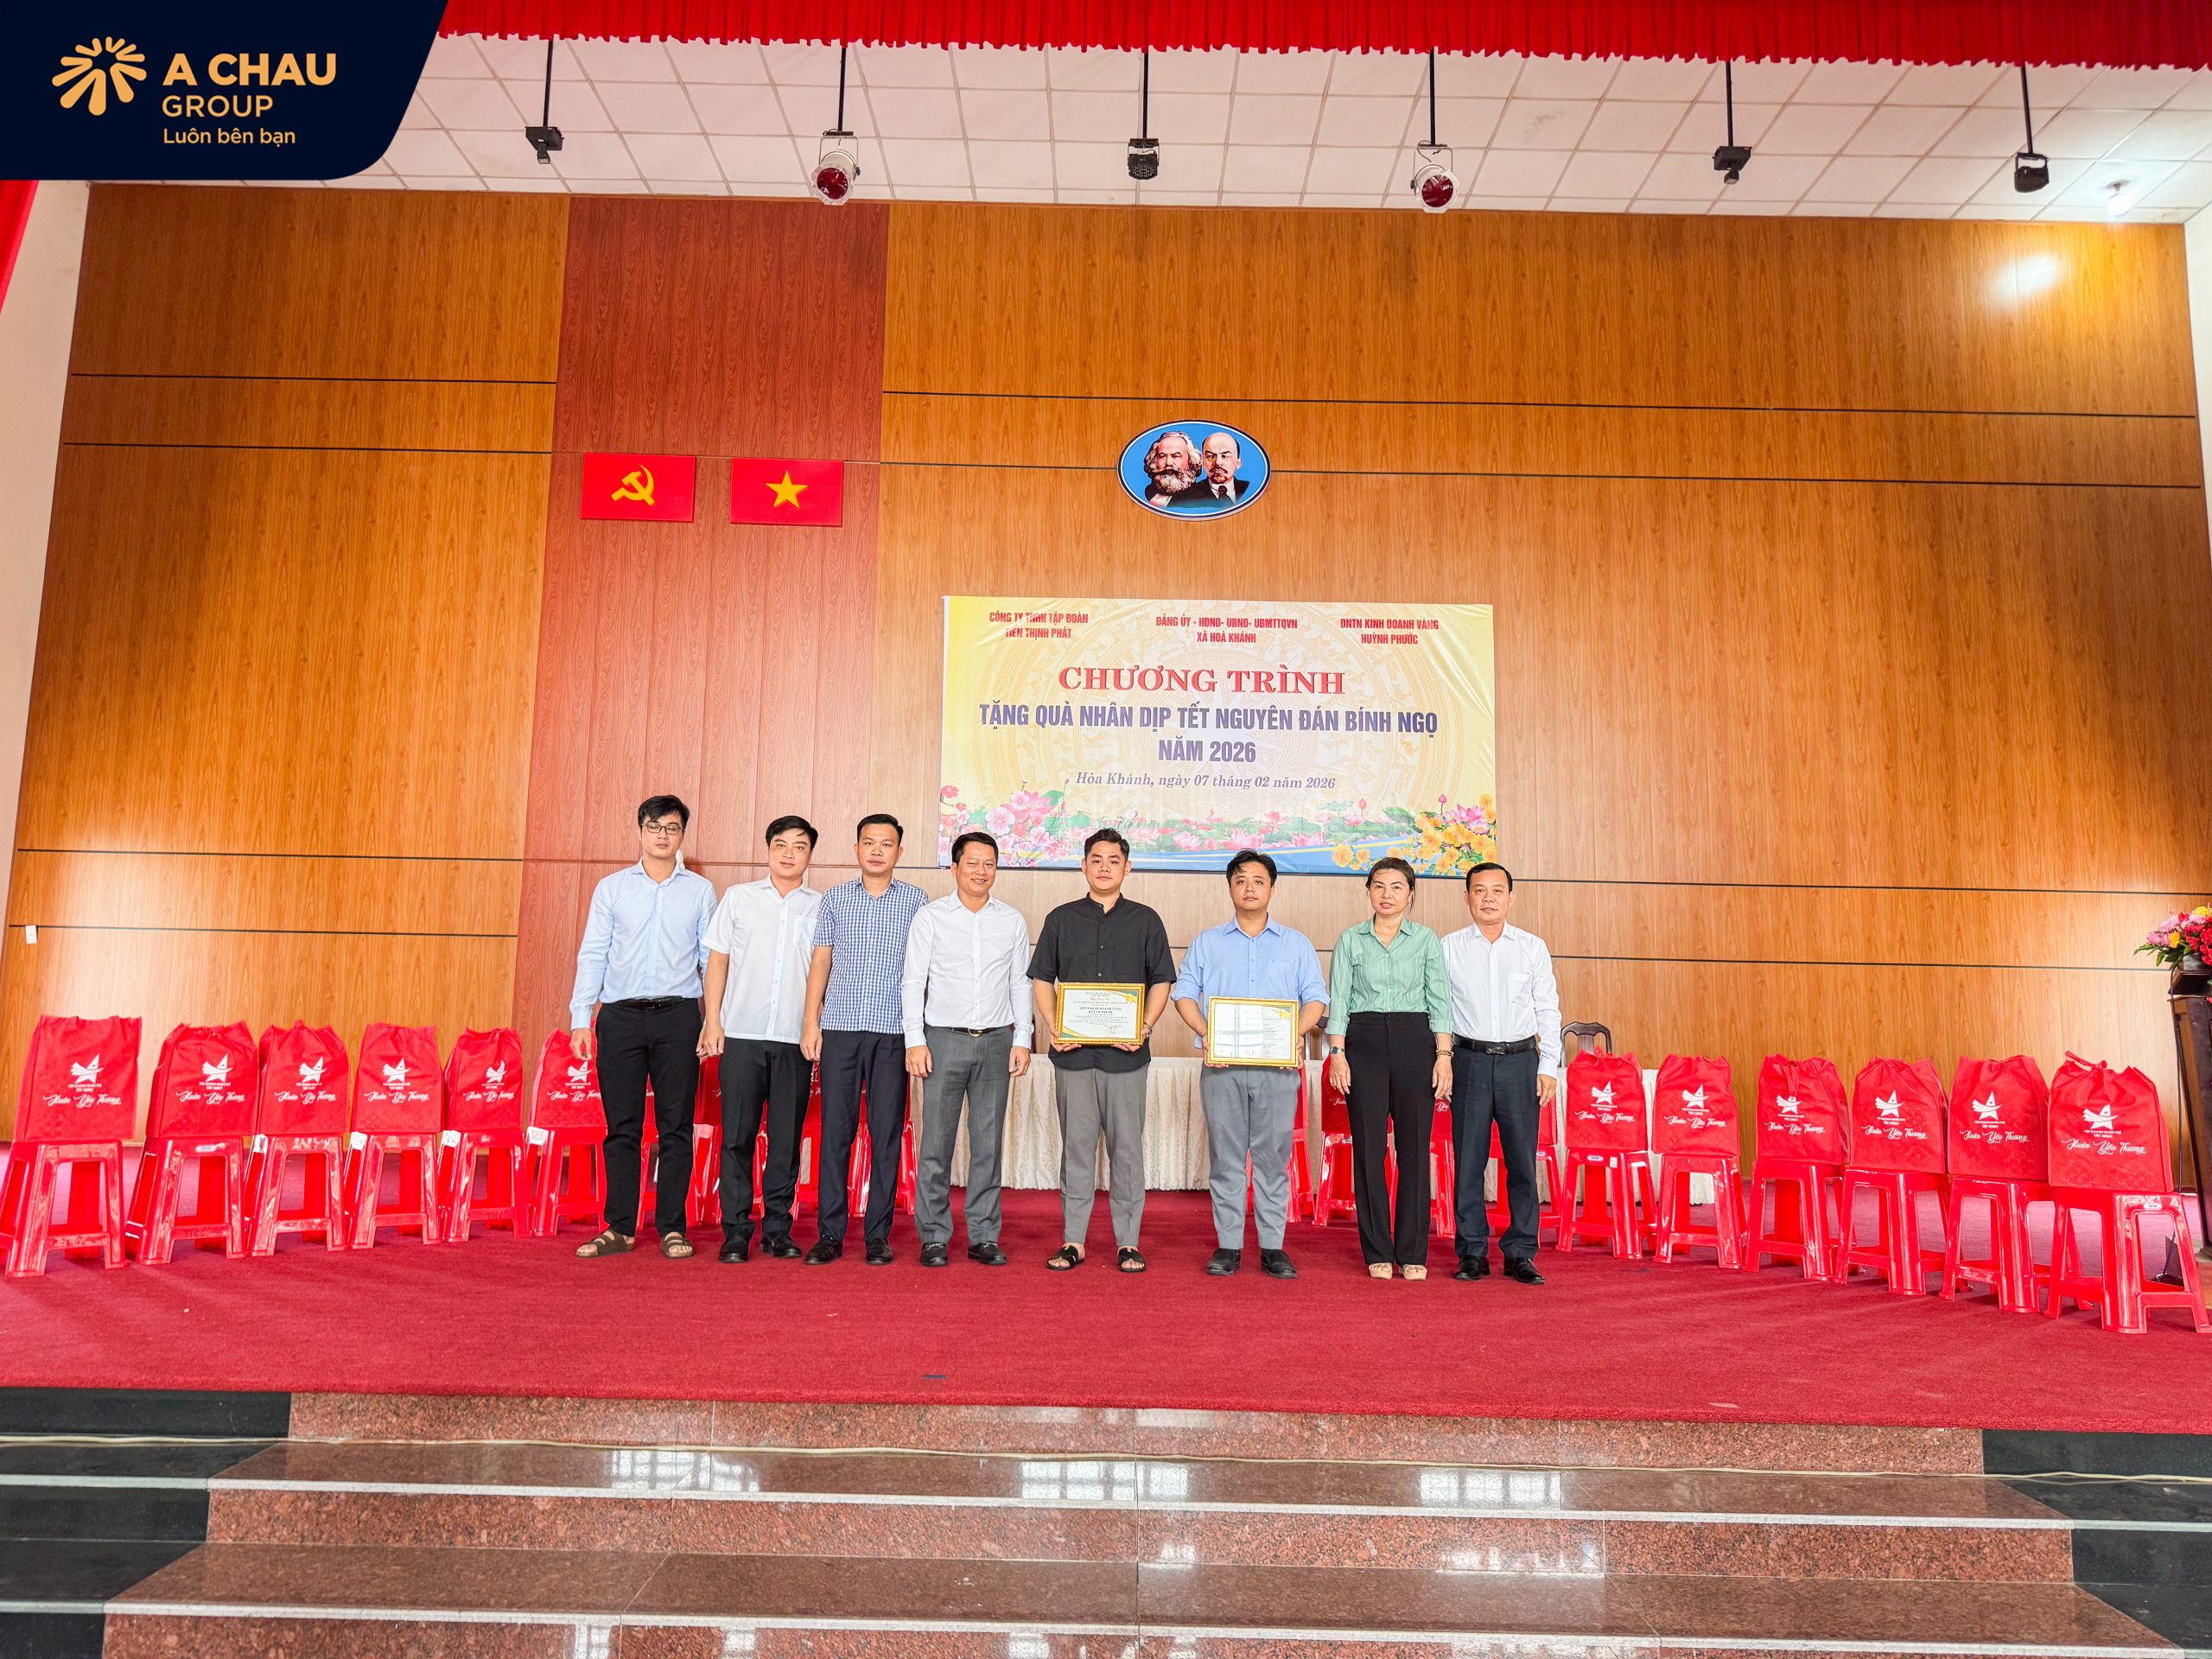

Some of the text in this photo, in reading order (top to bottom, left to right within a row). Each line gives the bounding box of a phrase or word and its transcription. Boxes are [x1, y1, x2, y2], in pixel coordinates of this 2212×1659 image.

[989, 610, 1012, 622] CÔNG
[1014, 613, 1023, 623] TY
[1049, 611, 1064, 625] TẬP
[1065, 612, 1089, 624] ĐOÀN
[1254, 618, 1298, 630] UBMTTQVN
[1340, 617, 1439, 630] DNTN KINH DOANH VÀNG
[1025, 628, 1049, 640] THỊNH
[1051, 626, 1072, 639] PHÁT
[1197, 631, 1256, 643] XÃ HOÀ KHÁNH
[1361, 632, 1419, 645] HUỲNH PHƯỚC
[1058, 664, 1345, 695] CHƯƠNG TRÌNH
[979, 699, 1438, 738] TẶNG QUÀ NHÂN DỊP TẾT NGUYÊN ĐÁN BÍNH NGỌ
[1158, 735, 1256, 763] NĂM 2026
[1076, 771, 1336, 790] Hòa Khánh, ngày 07 tháng 02 năm 2026
